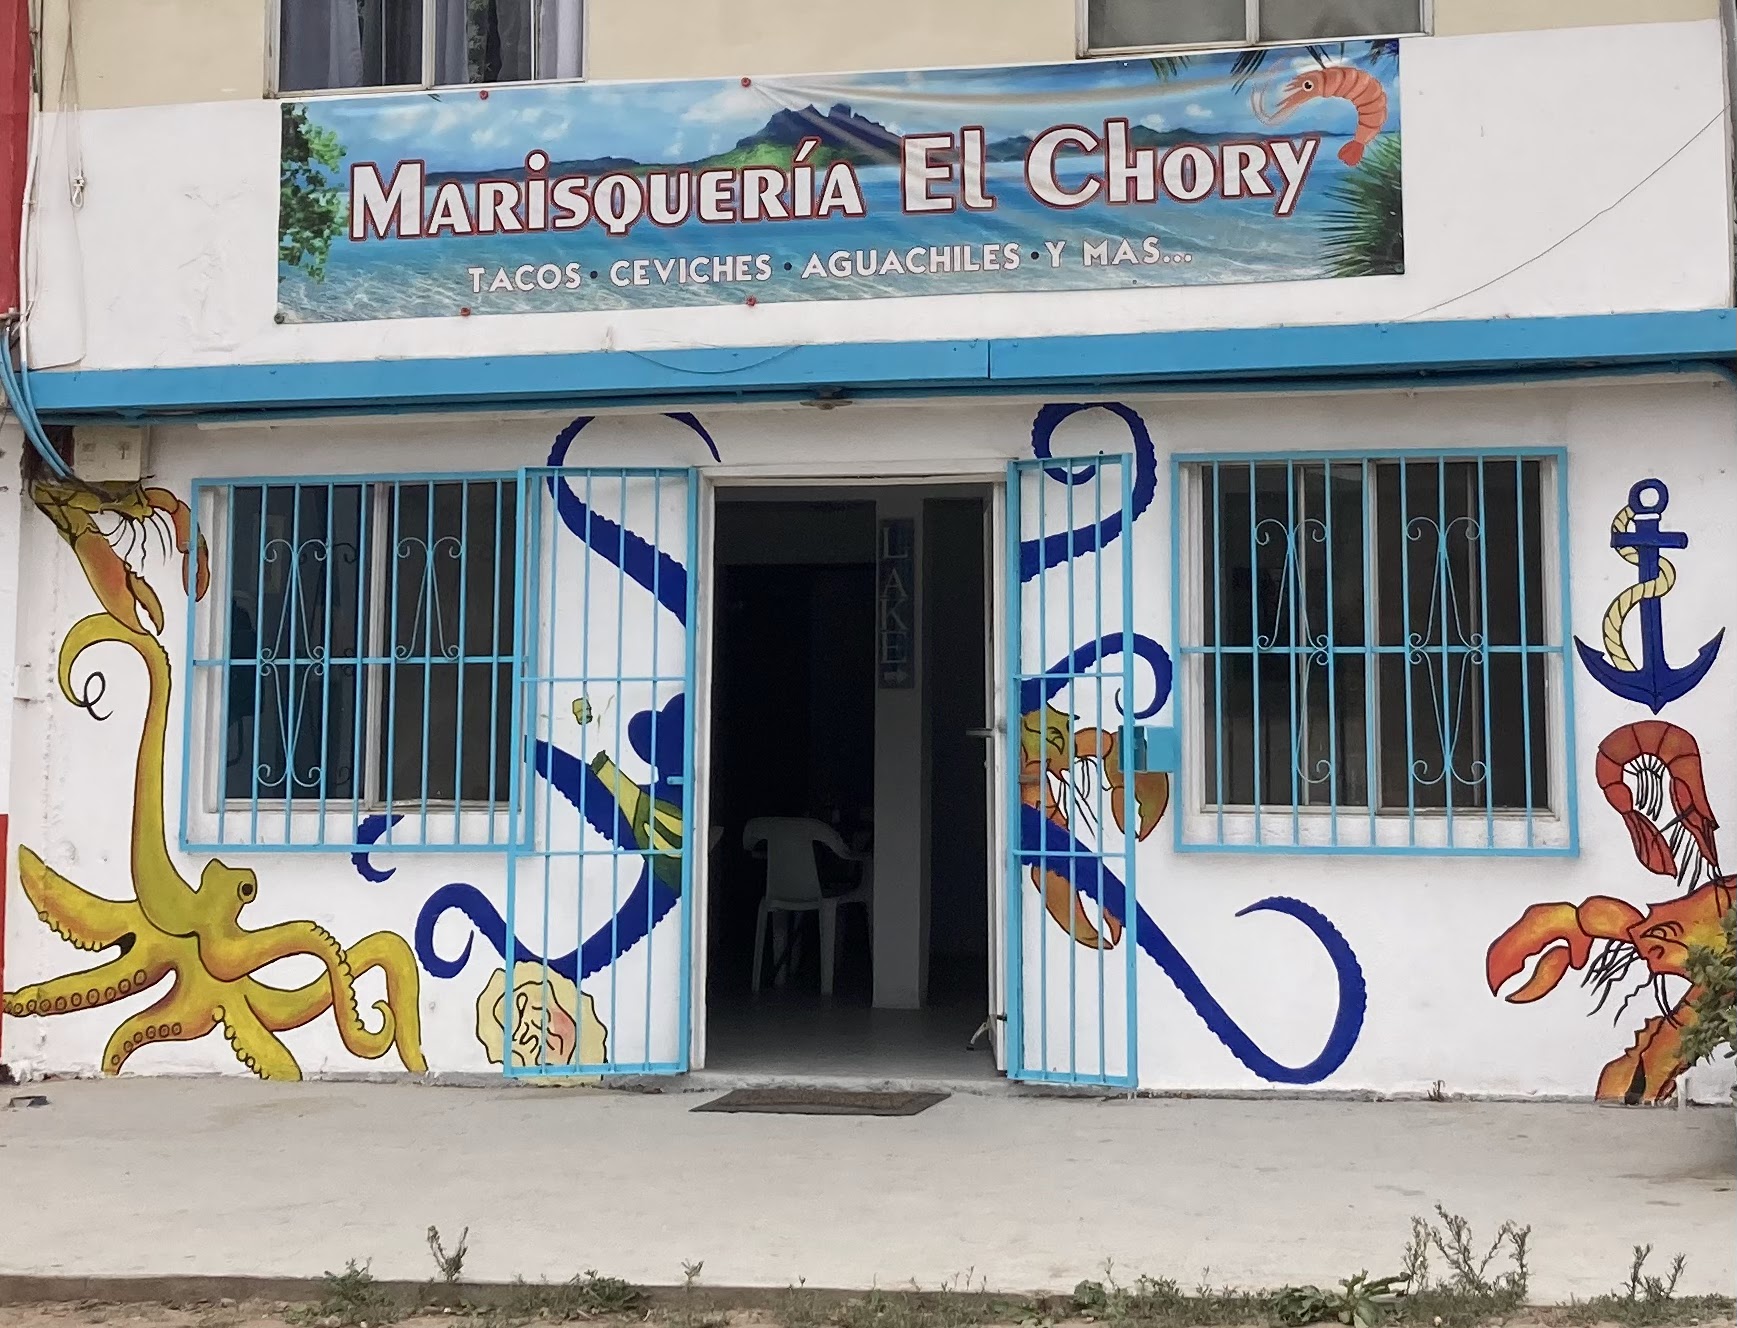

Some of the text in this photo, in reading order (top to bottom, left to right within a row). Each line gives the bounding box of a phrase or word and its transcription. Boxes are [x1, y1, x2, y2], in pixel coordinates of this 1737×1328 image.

[901, 124, 997, 215] El
[468, 236, 1194, 293] TACOS CEVICHES AGUACHILES Y MAS...
[879, 527, 910, 663] LAKE
